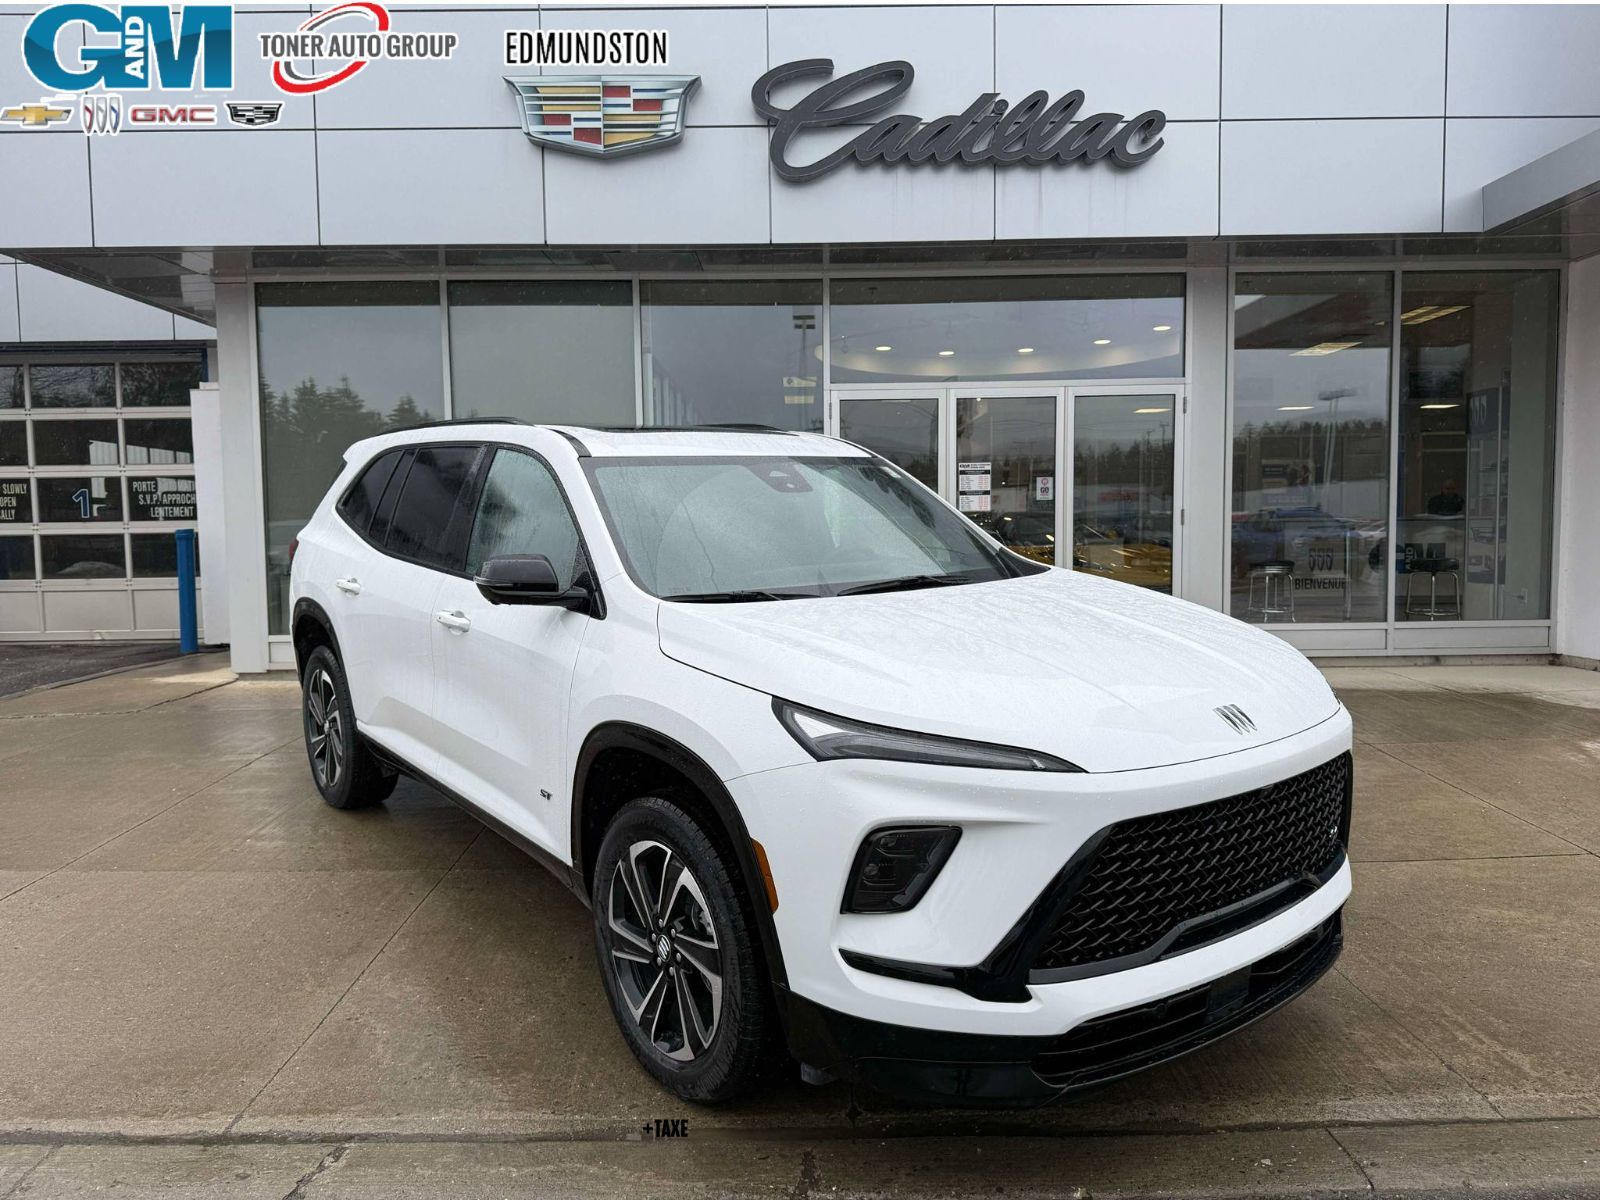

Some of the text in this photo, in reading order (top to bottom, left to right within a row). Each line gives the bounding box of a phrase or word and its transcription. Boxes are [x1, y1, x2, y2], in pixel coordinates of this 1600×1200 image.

[752, 58, 1166, 184] Cadillac
[2, 483, 27, 495] SLOWLY
[132, 481, 157, 492] PORTE
[72, 488, 90, 519] 1
[150, 506, 194, 518] LENTEMENT
[1294, 577, 1346, 590] BIENVENUE
